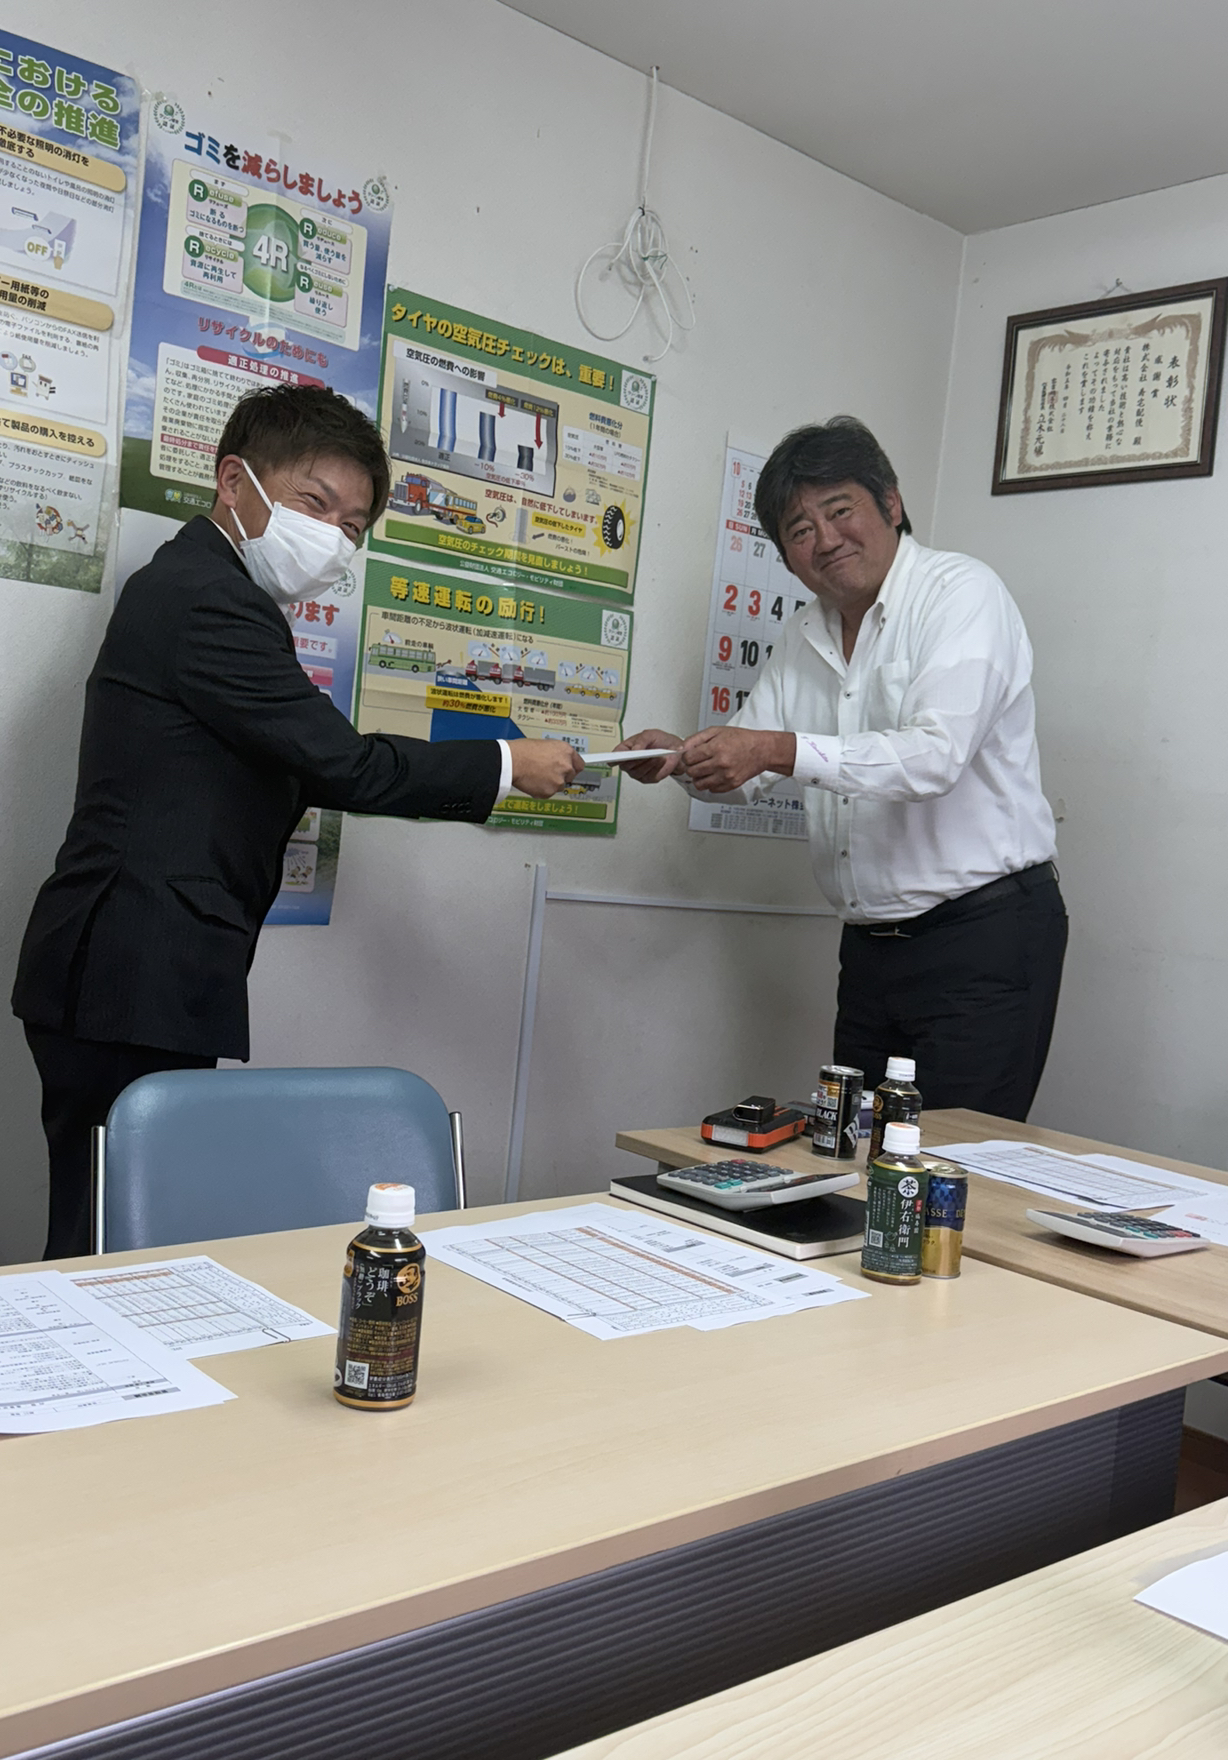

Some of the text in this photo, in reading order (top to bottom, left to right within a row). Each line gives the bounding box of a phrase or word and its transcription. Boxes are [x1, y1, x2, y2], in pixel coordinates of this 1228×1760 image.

[184, 130, 363, 214] ゴミを減らしましょう
[27, 241, 48, 257] OFF
[252, 235, 290, 272] 4R
[0, 277, 50, 300] ー用紙等の
[198, 316, 328, 367] リサイクルのためにも
[228, 354, 299, 384] 適正処理の推進
[406, 348, 486, 382] 空気圧の燃費への影響
[1139, 343, 1150, 382] 株式会社
[1164, 355, 1180, 409] 表彰状
[0, 417, 95, 448] て製品の購入を控える
[730, 536, 742, 552] 26
[753, 541, 766, 558] 27
[390, 576, 545, 623] 等速運転の励行！
[723, 584, 738, 611] 2
[748, 590, 762, 616] 3
[771, 596, 783, 621] 4
[718, 636, 732, 662] 9
[740, 640, 759, 667] 10
[712, 686, 730, 713] 16
[901, 1180, 916, 1196] 茶
[897, 1199, 913, 1248] 伊右衛門
[396, 1292, 418, 1306] BOSS
